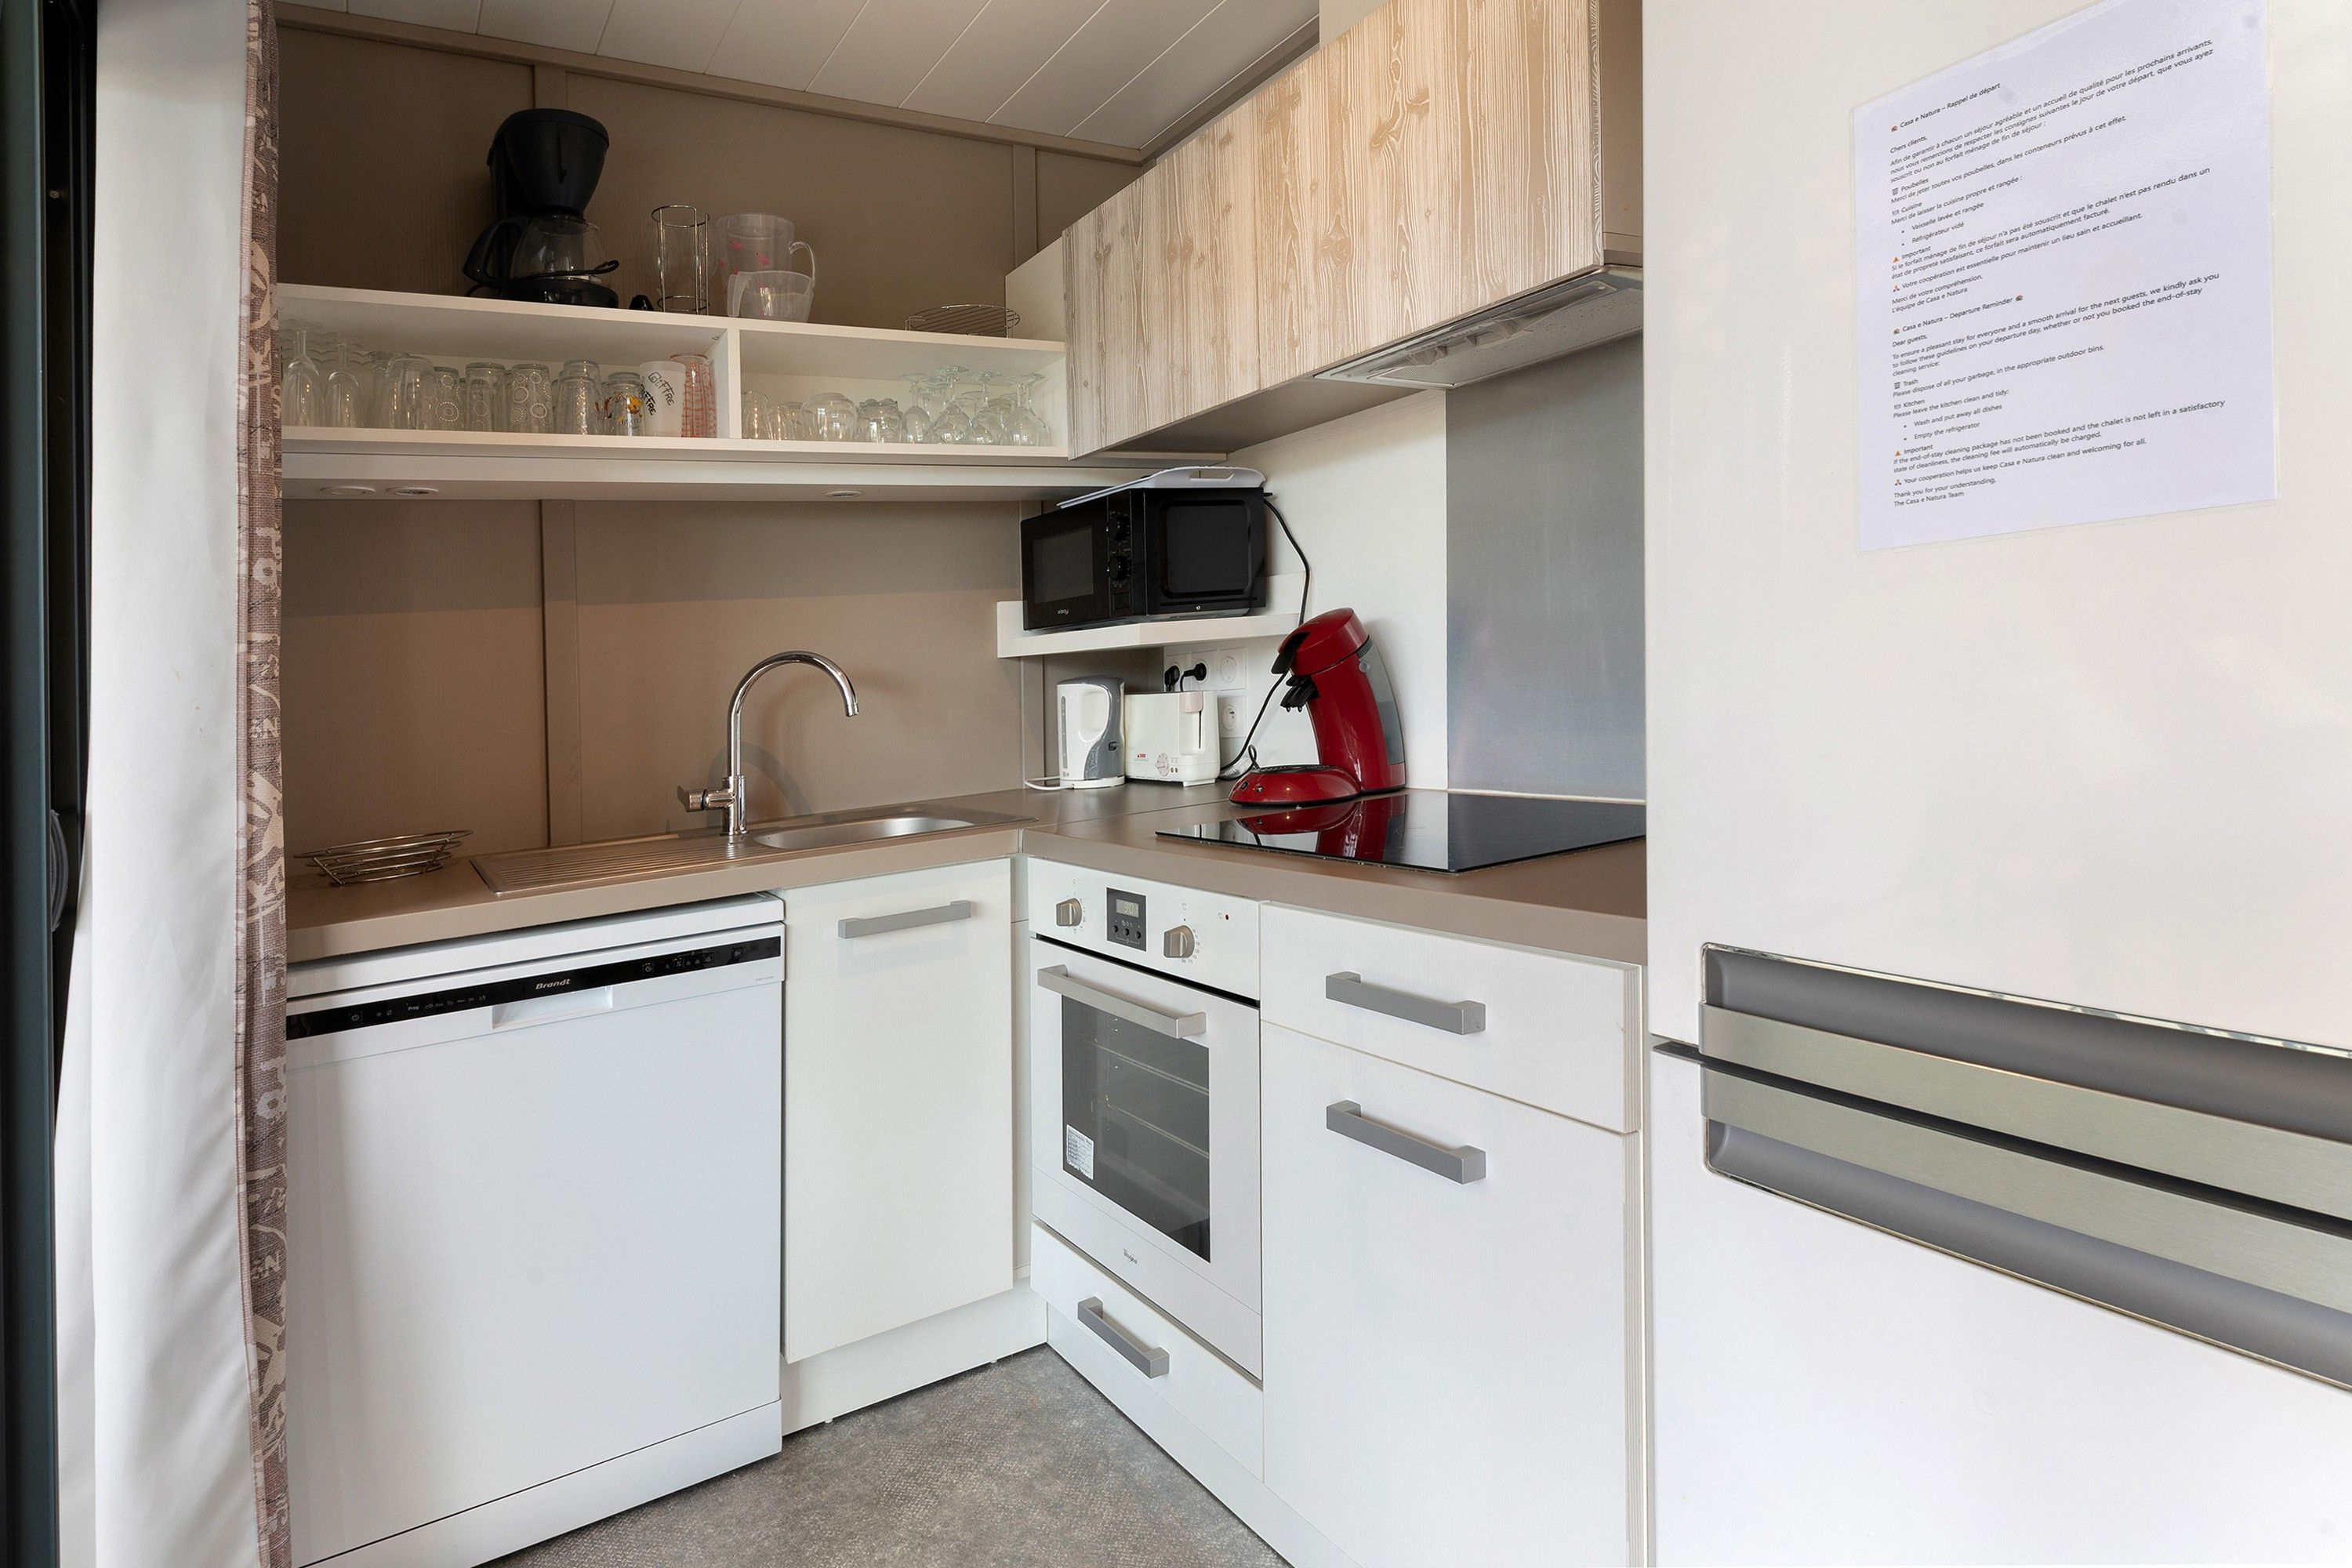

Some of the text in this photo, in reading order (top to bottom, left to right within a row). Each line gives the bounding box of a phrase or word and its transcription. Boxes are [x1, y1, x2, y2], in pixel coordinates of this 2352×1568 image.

[1889, 158, 1902, 166] Afin
[1911, 145, 1935, 160] garantir
[1940, 134, 1963, 147] chacun
[1973, 122, 1994, 134] séjour
[1994, 111, 2023, 126] agréable
[2043, 93, 2067, 108] accueil
[2079, 79, 2104, 94] qualité
[2105, 73, 2124, 85] pour
[2124, 68, 2136, 76] les
[2137, 53, 2175, 73] prochains
[1899, 119, 1914, 128] Casa
[1920, 108, 1940, 120] Natura
[1946, 95, 1968, 109] Rappel
[1978, 83, 2000, 96] départ
[1890, 193, 1907, 204] Merci
[1916, 185, 1931, 197] jeter
[1931, 178, 1950, 189] toutes
[1996, 156, 2013, 166] dans
[2024, 138, 2062, 156] conteneurs
[2063, 129, 2087, 143] prévus
[2094, 122, 2106, 131] cet
[1901, 178, 1929, 192] Poubelles
[1904, 256, 1923, 267] forfait
[1923, 249, 1948, 261] ménage
[1977, 234, 1997, 244] séjour
[2009, 226, 2021, 235] pas
[2022, 221, 2033, 230] été
[2034, 213, 2061, 226] souscrit
[2071, 206, 2085, 215] que
[2094, 196, 2117, 207] chalet
[2138, 185, 2151, 196] pas
[2153, 178, 2176, 189] rendu
[2178, 171, 2197, 182] dans
[1911, 218, 1936, 230] Vaisselle
[1937, 212, 1953, 222] lavée
[1961, 202, 1984, 213] rangée
[1901, 280, 1918, 289] Votre
[1918, 269, 1955, 284] coopération
[1966, 255, 1999, 269] essentielle
[2000, 250, 2017, 261] pour
[2017, 240, 2050, 254] maintenir
[2076, 228, 2091, 237] sain
[1900, 349, 1920, 358] ensure
[1926, 340, 1951, 353] pleasant
[1976, 327, 2006, 339] everyone
[2007, 322, 2021, 331] and
[2027, 314, 2054, 326] smooth
[2055, 307, 2077, 319] arrival
[2103, 297, 2120, 306] next
[2163, 281, 2187, 291] kindly
[2188, 277, 2202, 286] ask
[2203, 273, 2219, 283] you
[1922, 317, 1943, 326] Natura
[1949, 306, 1981, 319] Departure
[1982, 297, 2013, 310] Reminder
[1892, 389, 1911, 397] Please
[1912, 384, 1935, 393] dispose
[1951, 376, 1967, 386] your
[2016, 356, 2056, 369] appropriate
[2057, 349, 2087, 360] outdoor
[1902, 378, 1918, 387] Trash
[1909, 451, 1944, 462] end-of-stay
[1944, 446, 1971, 455] cleaning
[1971, 441, 1999, 452] package
[2043, 426, 2070, 437] booked
[2071, 424, 2086, 432] and
[2100, 418, 2123, 427] chalet
[2147, 410, 2161, 418] left
[2179, 400, 2225, 413] satisfactory
[1913, 418, 1930, 426] Wash
[1931, 415, 1943, 423] and
[1944, 413, 1955, 422] put
[1981, 404, 2002, 413] dishes
[1903, 444, 1933, 454] Important
[535, 978, 571, 990] Brandt
